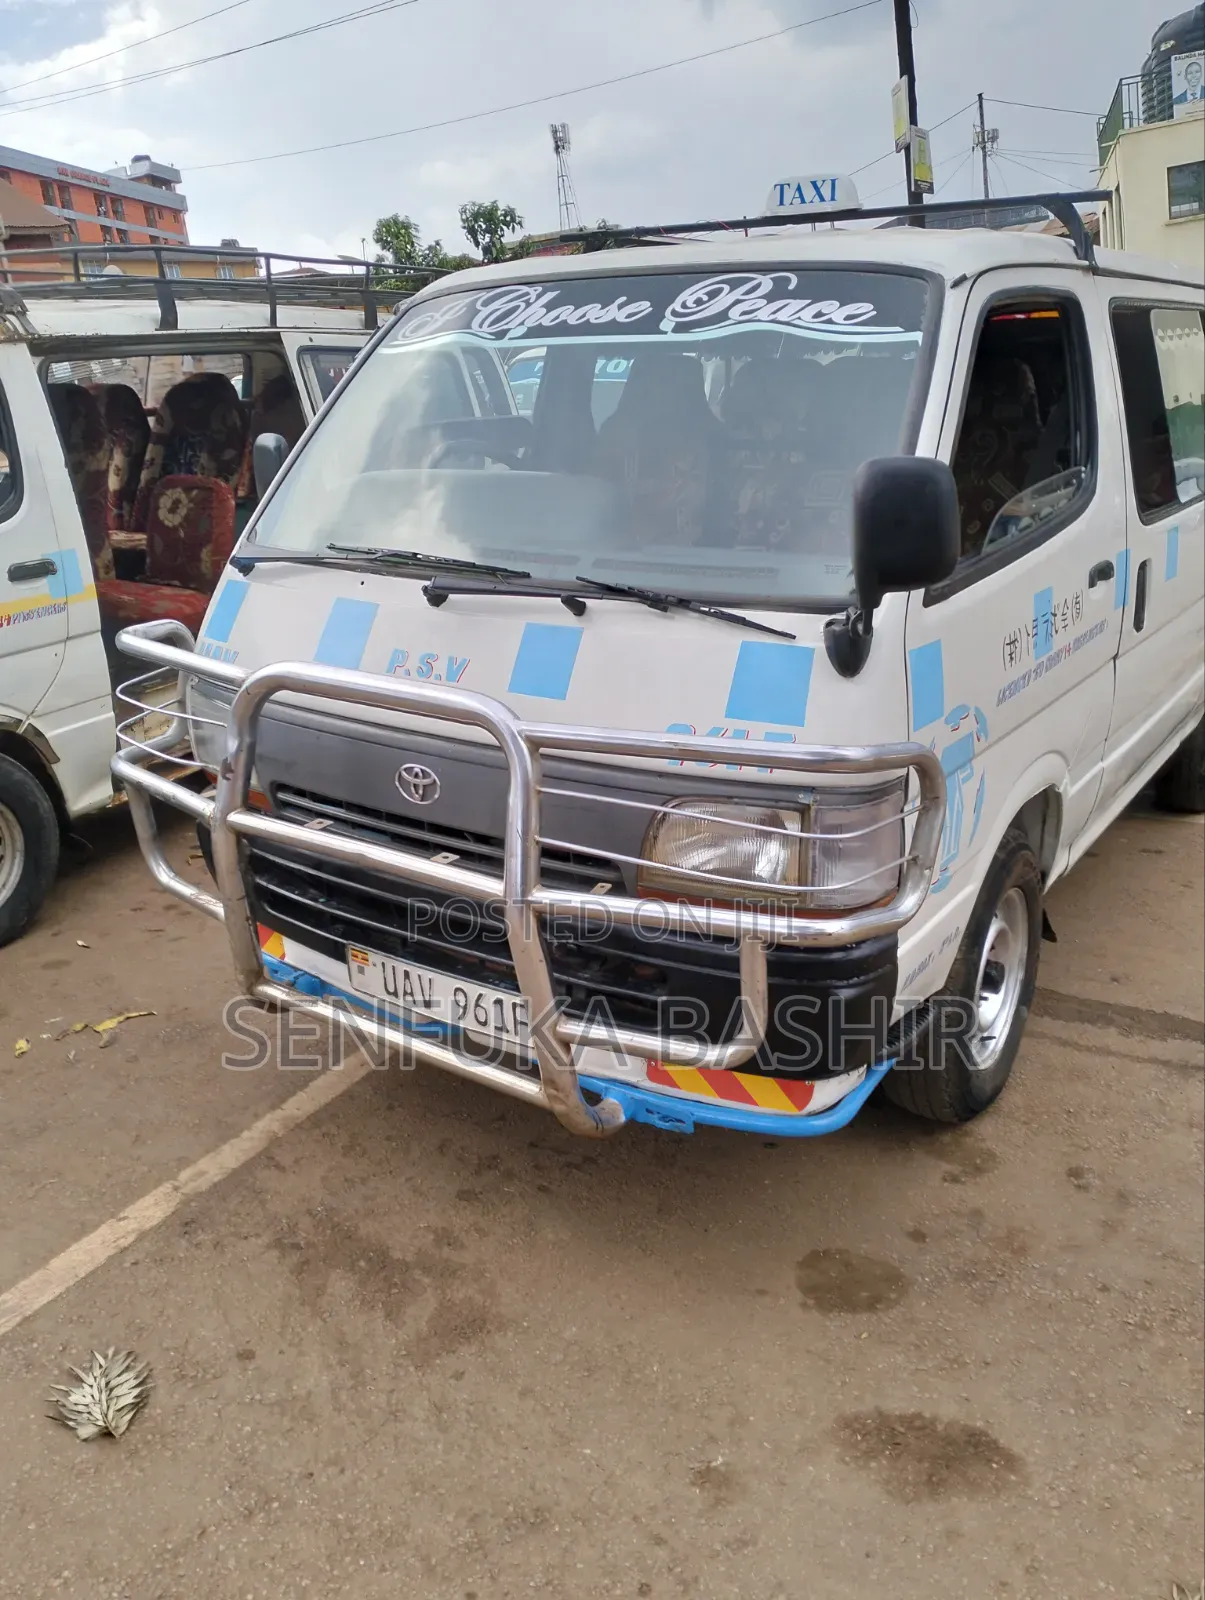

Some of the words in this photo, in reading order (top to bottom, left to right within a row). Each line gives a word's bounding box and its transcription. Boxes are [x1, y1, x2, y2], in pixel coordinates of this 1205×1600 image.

[773, 177, 839, 207] TAXI
[471, 285, 653, 336] Choose
[664, 272, 878, 330] Peace
[385, 648, 471, 684] P.S.V
[381, 961, 434, 1010] UAV
